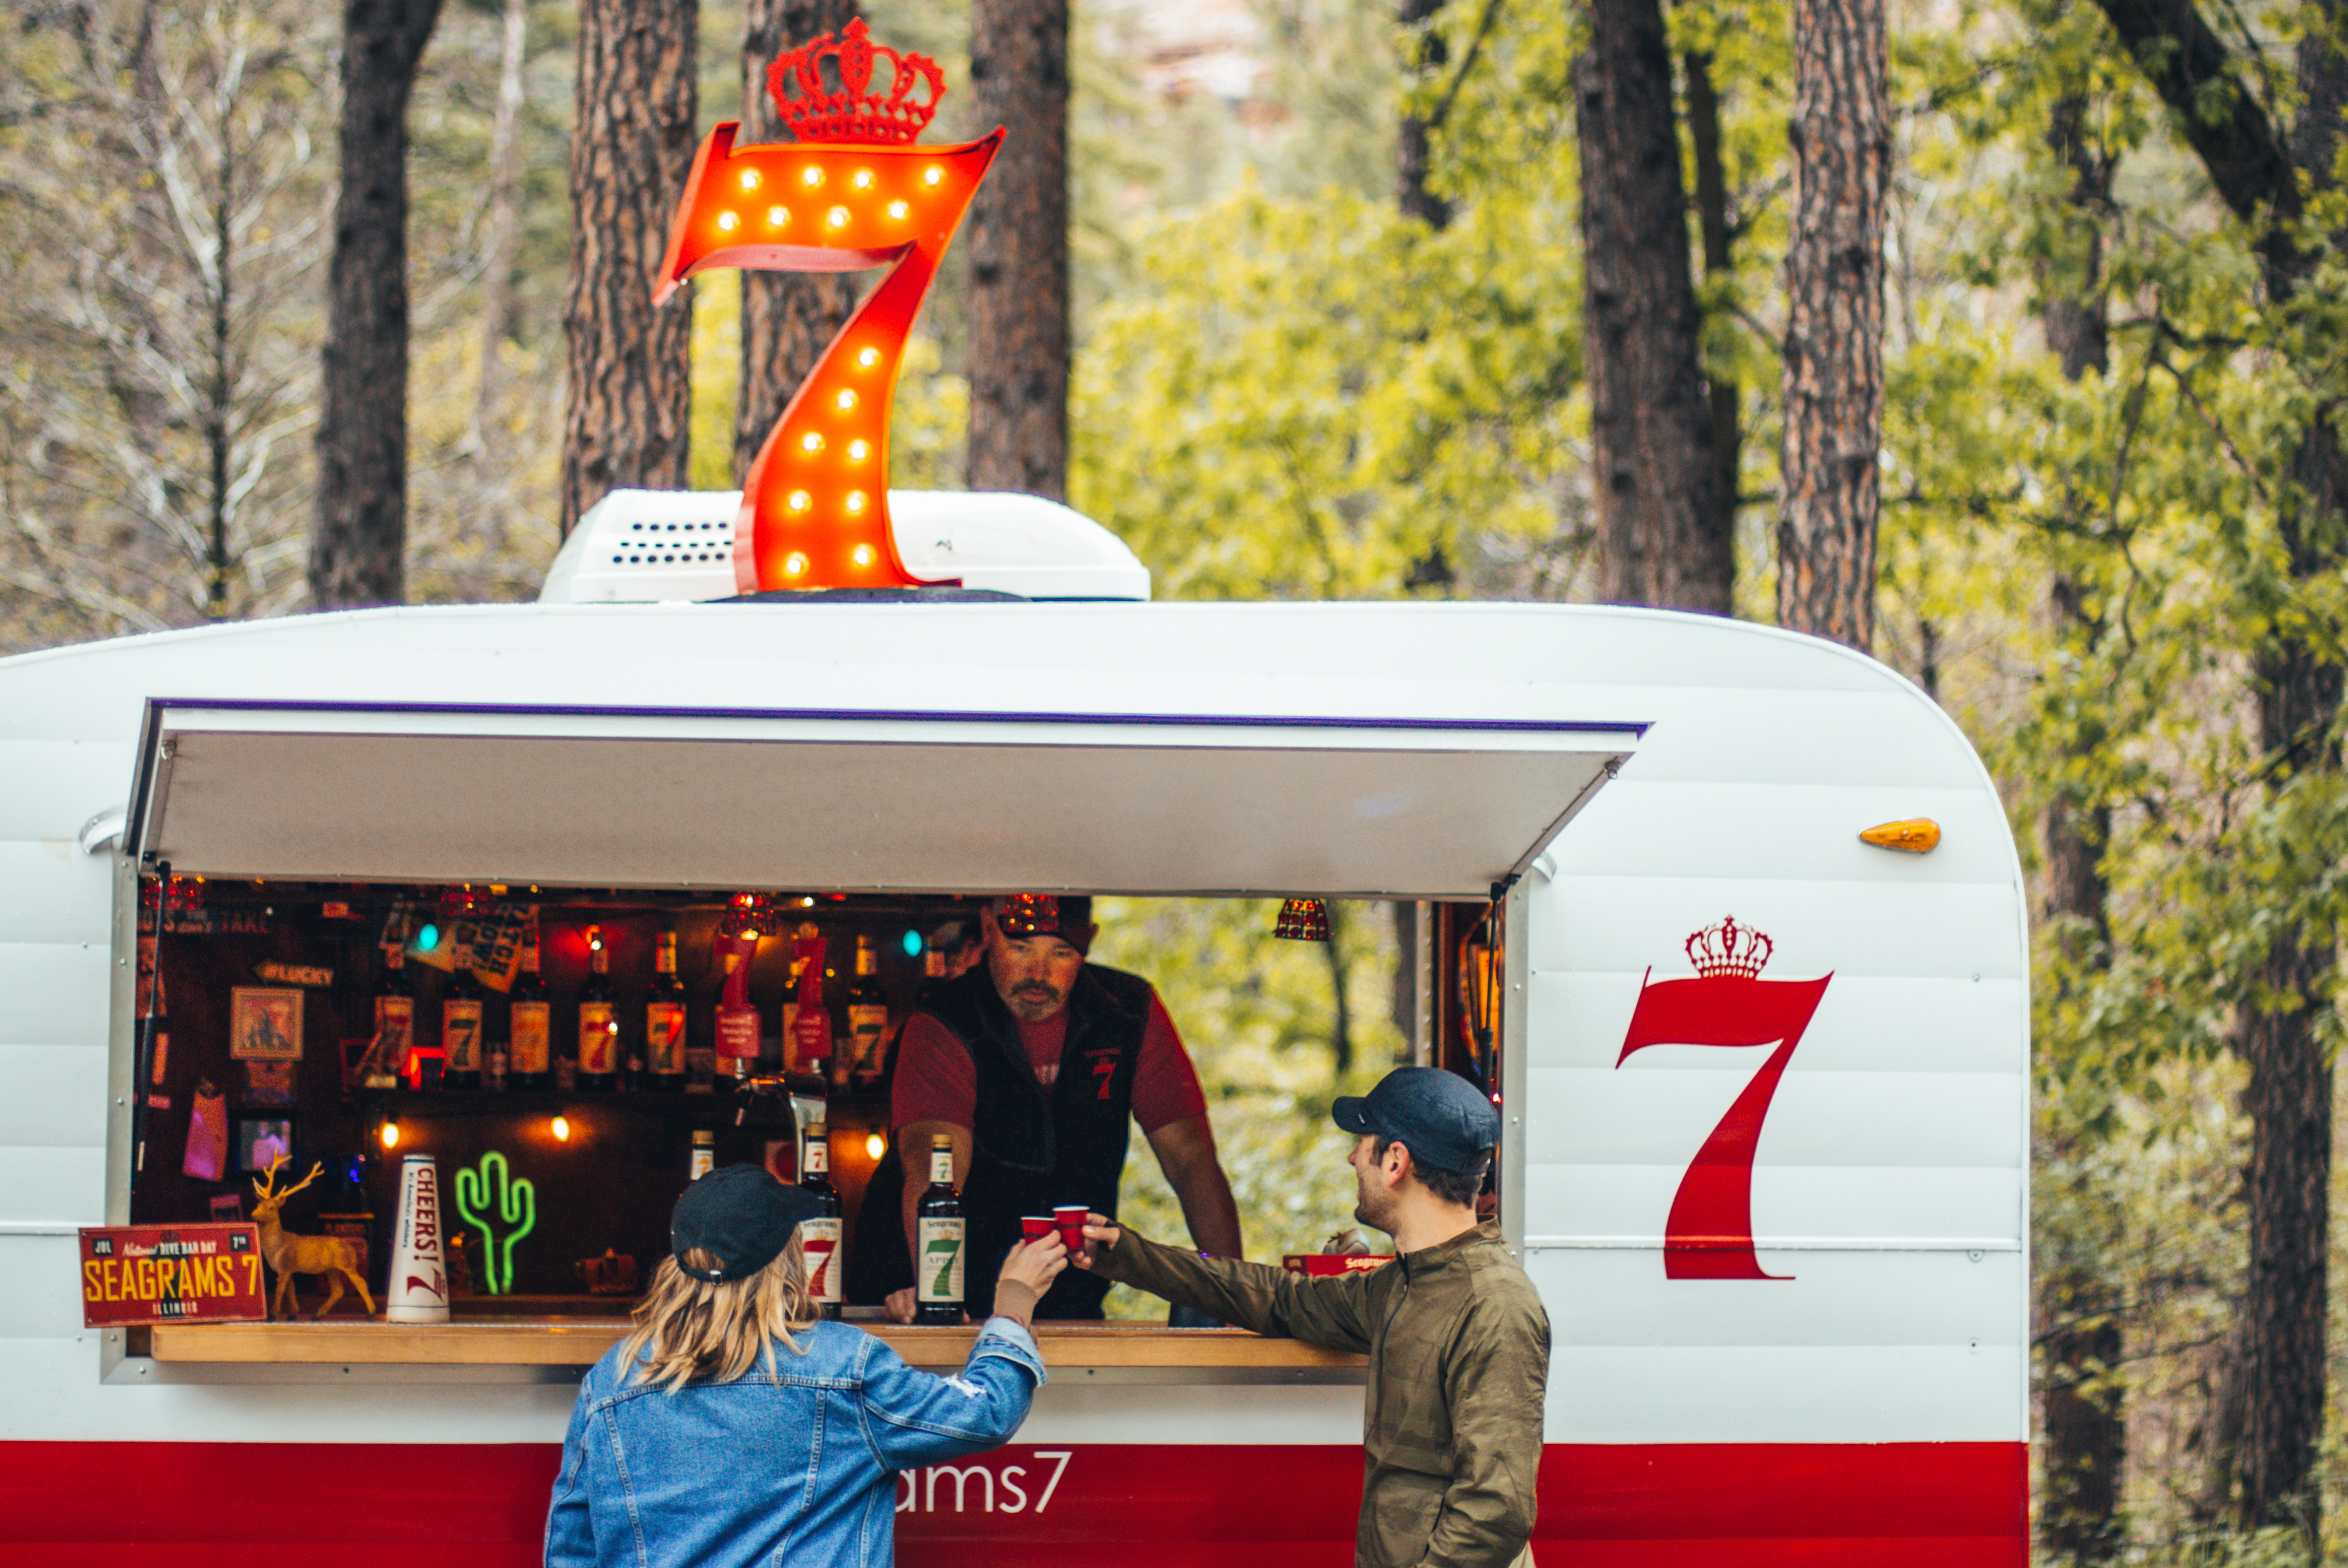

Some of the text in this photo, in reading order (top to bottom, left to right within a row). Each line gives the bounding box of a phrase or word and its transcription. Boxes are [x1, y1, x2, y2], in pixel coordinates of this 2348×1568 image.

[652, 121, 1007, 596] 7
[448, 1018, 478, 1067] 7
[1093, 1062, 1117, 1099] 7
[1615, 965, 1834, 1280] 7
[813, 1151, 824, 1169] 7
[938, 1162, 950, 1179] 7
[414, 1167, 439, 1263] CHEERS!
[95, 1240, 112, 1254] JUL
[159, 1241, 181, 1255] DIVE
[181, 1241, 199, 1255] BAR
[201, 1240, 217, 1254] DAY
[925, 1239, 961, 1296] 7
[84, 1254, 259, 1302] SEAGRAMS 7
[406, 1267, 444, 1302] 7
[803, 1240, 838, 1297] 7
[152, 1301, 198, 1315] ILLINOIS
